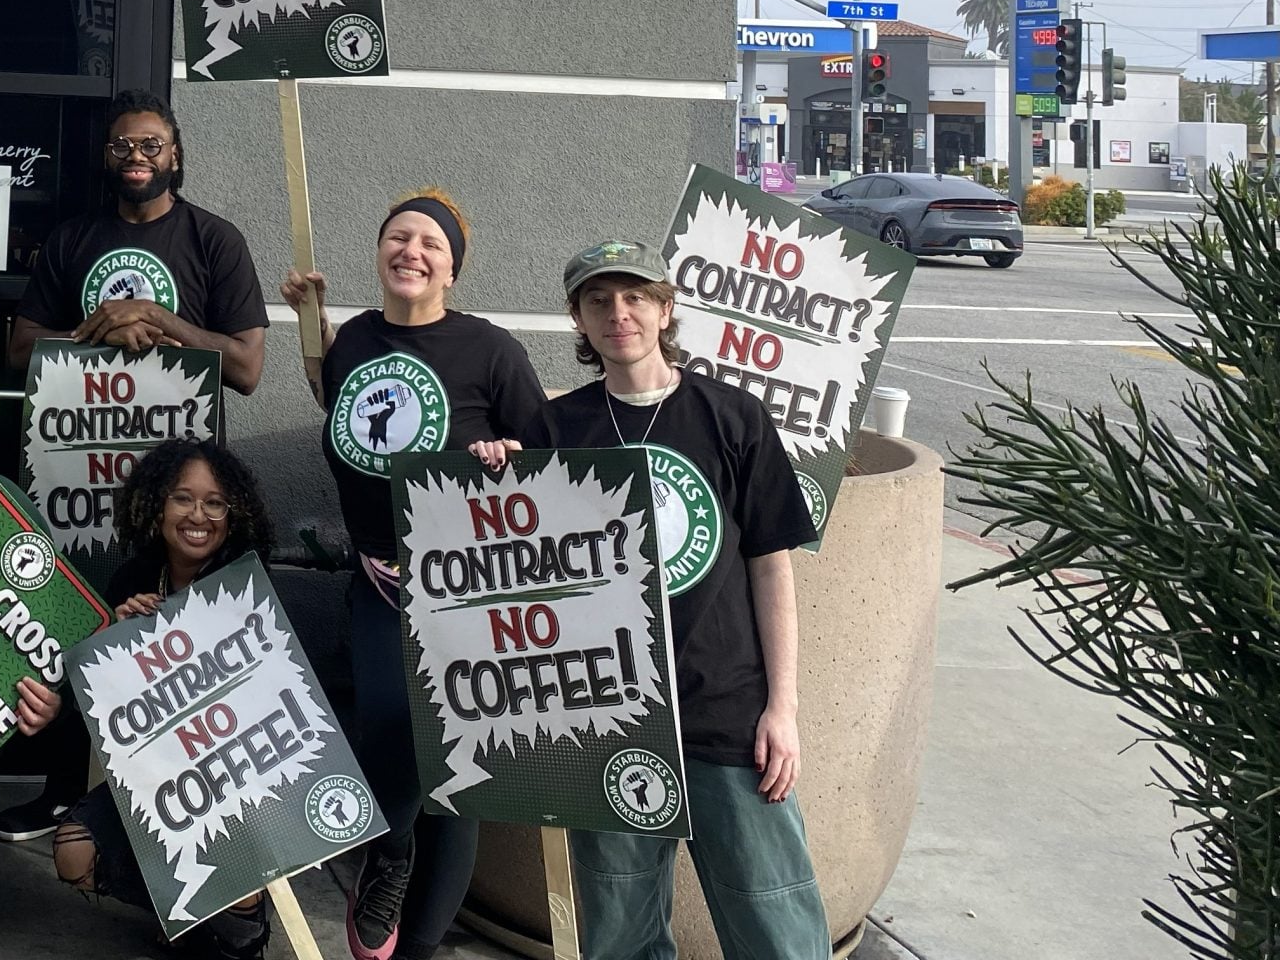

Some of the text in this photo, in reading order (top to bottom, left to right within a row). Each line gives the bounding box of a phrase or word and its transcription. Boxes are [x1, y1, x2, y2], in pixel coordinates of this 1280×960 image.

[842, 5, 885, 16] 7th St
[329, 18, 380, 69] STARBUCKS WORKERS UNITED
[98, 255, 168, 290] STARBUCKS
[740, 229, 805, 281] NO
[676, 255, 872, 343] CONTRACT?
[717, 321, 783, 372] NO
[83, 372, 135, 405] NO
[360, 361, 439, 406] STARBUCKS
[39, 398, 199, 443] CONTRACT?
[336, 395, 371, 467] WORKERS
[87, 452, 138, 484] NO
[798, 476, 821, 502] BUCKS
[466, 492, 539, 541] NO
[4, 536, 52, 587] STARBUCKS WORKERS UNITED
[420, 519, 629, 599] CONTRACT?
[486, 603, 560, 652] NO
[107, 613, 273, 746] CONTRACT?
[132, 629, 194, 683] NO
[443, 626, 641, 721] COFFEE!
[173, 702, 238, 761] NO
[154, 688, 316, 832] COFFEE!
[310, 779, 368, 838] STARBUCKS WORKERS UNITED
[609, 753, 676, 824] STARBUCKS WORKERS UNITED
